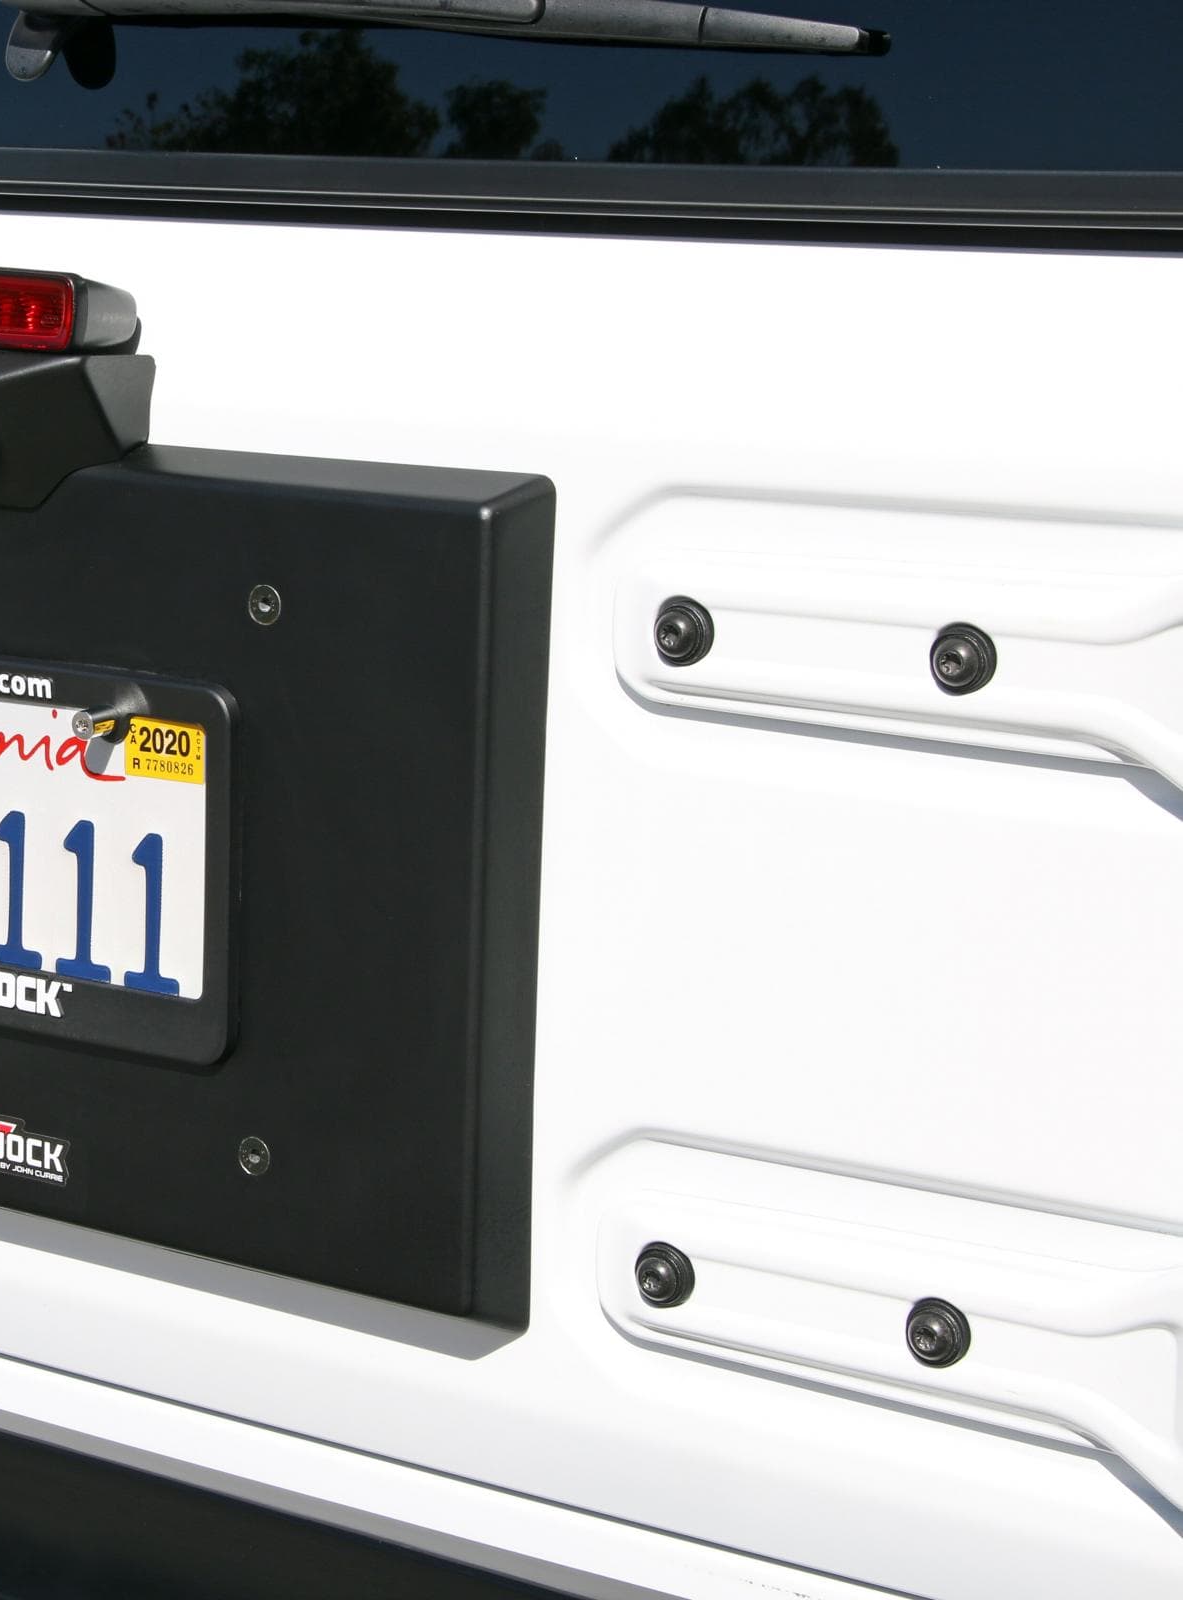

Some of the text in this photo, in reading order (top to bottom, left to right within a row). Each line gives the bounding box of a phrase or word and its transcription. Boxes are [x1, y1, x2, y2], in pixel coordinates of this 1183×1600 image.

[139, 726, 191, 757] 2020
[132, 758, 194, 776] R 7780826
[0, 1161, 11, 1170] BY
[12, 1164, 34, 1176] JOHN
